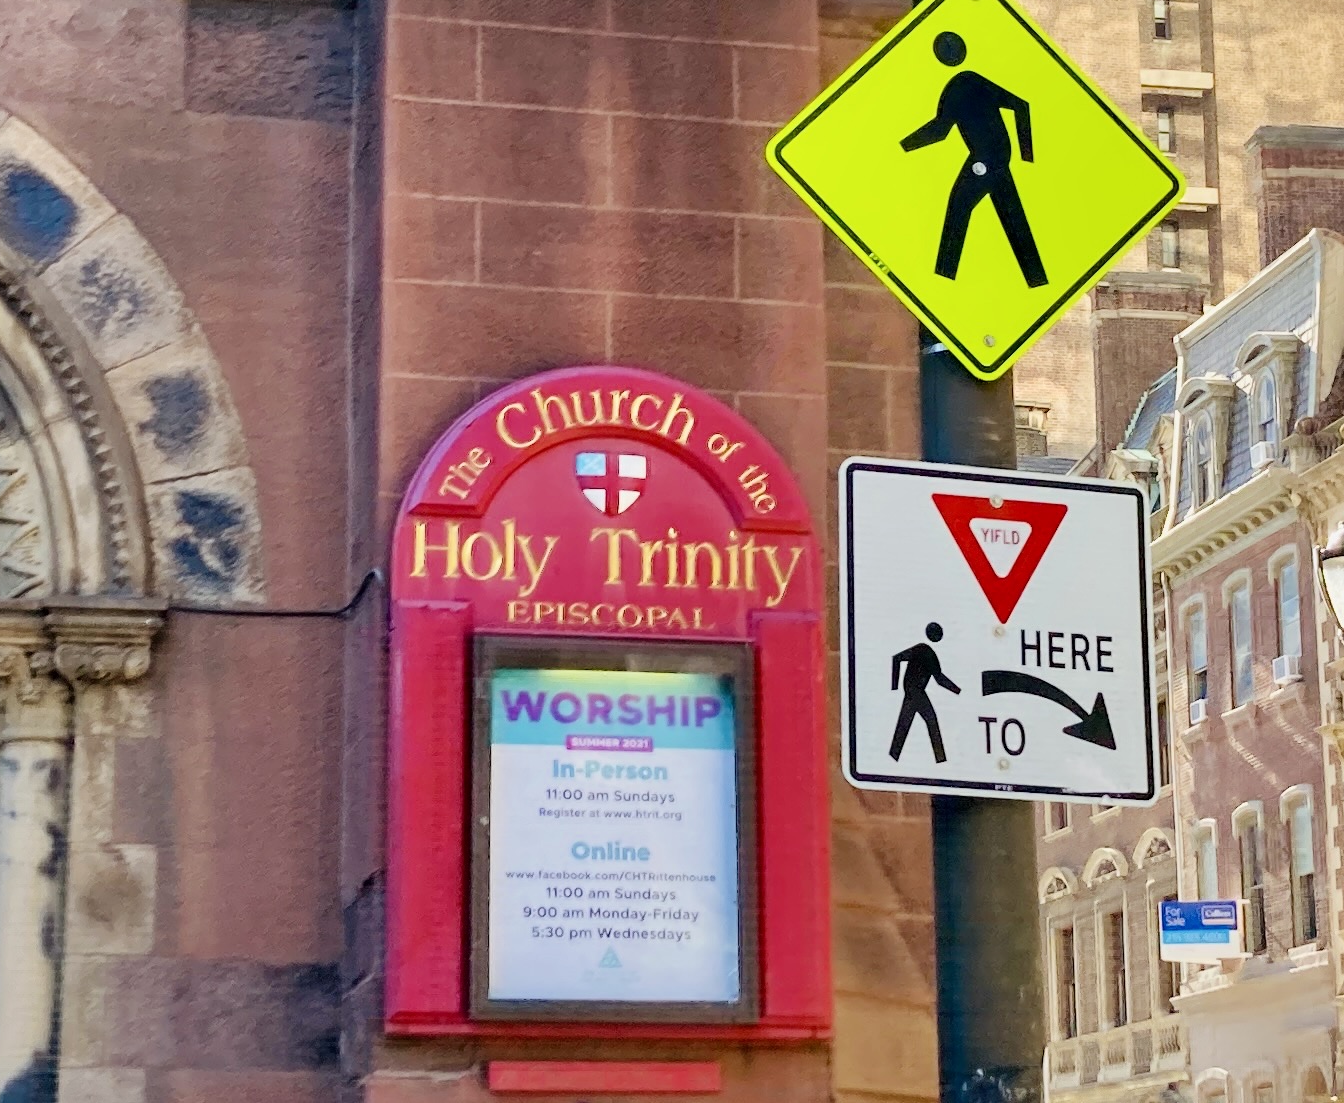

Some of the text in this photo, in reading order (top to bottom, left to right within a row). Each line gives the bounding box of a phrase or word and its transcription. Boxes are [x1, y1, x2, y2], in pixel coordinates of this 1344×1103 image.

[440, 386, 777, 516] The Church of the
[979, 527, 1021, 546] YIELD
[408, 517, 805, 608] Holy Trinity
[505, 600, 716, 631] EPISCOPAL
[1020, 628, 1115, 674] HERE
[500, 689, 722, 728] WORSHIP
[570, 736, 650, 749] SUMMER 2021
[977, 716, 1026, 756] TO
[551, 758, 669, 781] In-Person
[545, 788, 676, 804] 11:00 am Sundays
[538, 807, 683, 822] Register at www.htrit.org
[570, 839, 651, 862] Online
[504, 869, 717, 883] www.facebook.com/CHTRittenhouse
[545, 886, 677, 902] 11:00 am Sundays
[522, 905, 700, 923] 9:00 am Monday-Friday
[1165, 906, 1181, 917] For
[1165, 915, 1186, 927] Sale
[530, 925, 693, 943] 5:30 pm Wednesdays
